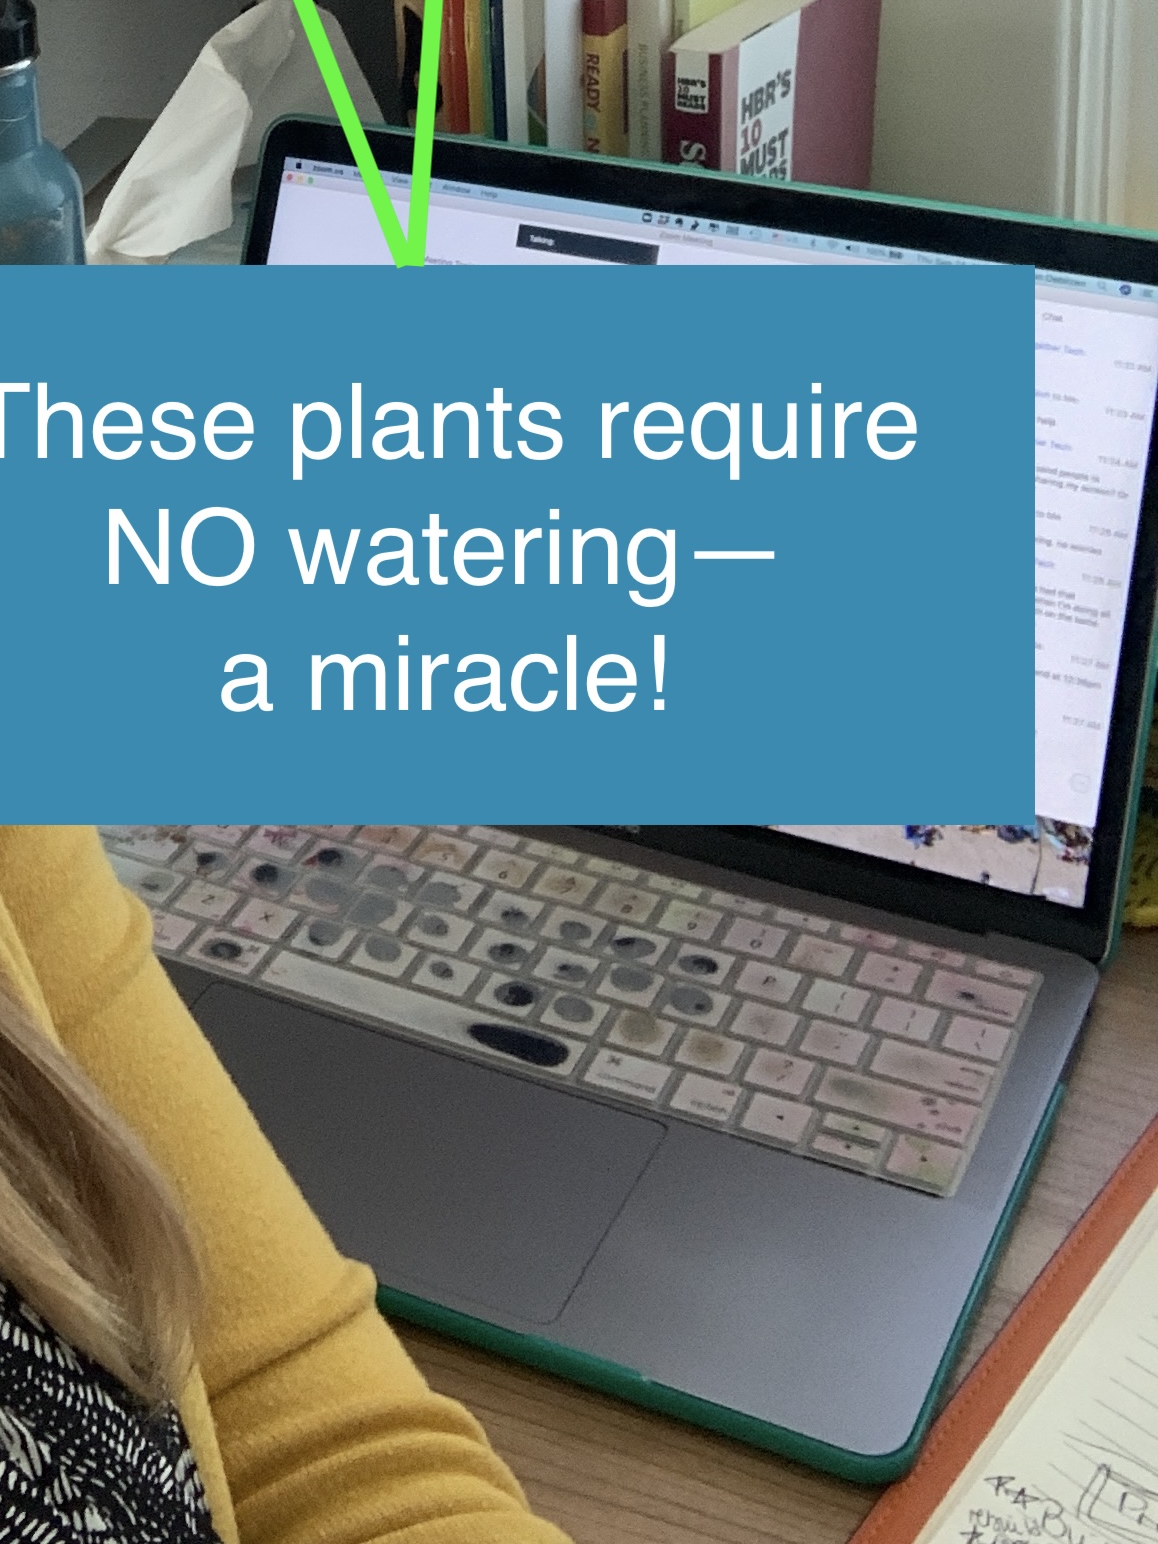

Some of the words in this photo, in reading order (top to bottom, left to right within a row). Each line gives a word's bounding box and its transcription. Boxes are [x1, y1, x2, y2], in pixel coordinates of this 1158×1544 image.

[585, 53, 601, 113] READY
[740, 69, 791, 125] HBR'S
[740, 118, 762, 156] 10
[740, 127, 789, 176] MUST
